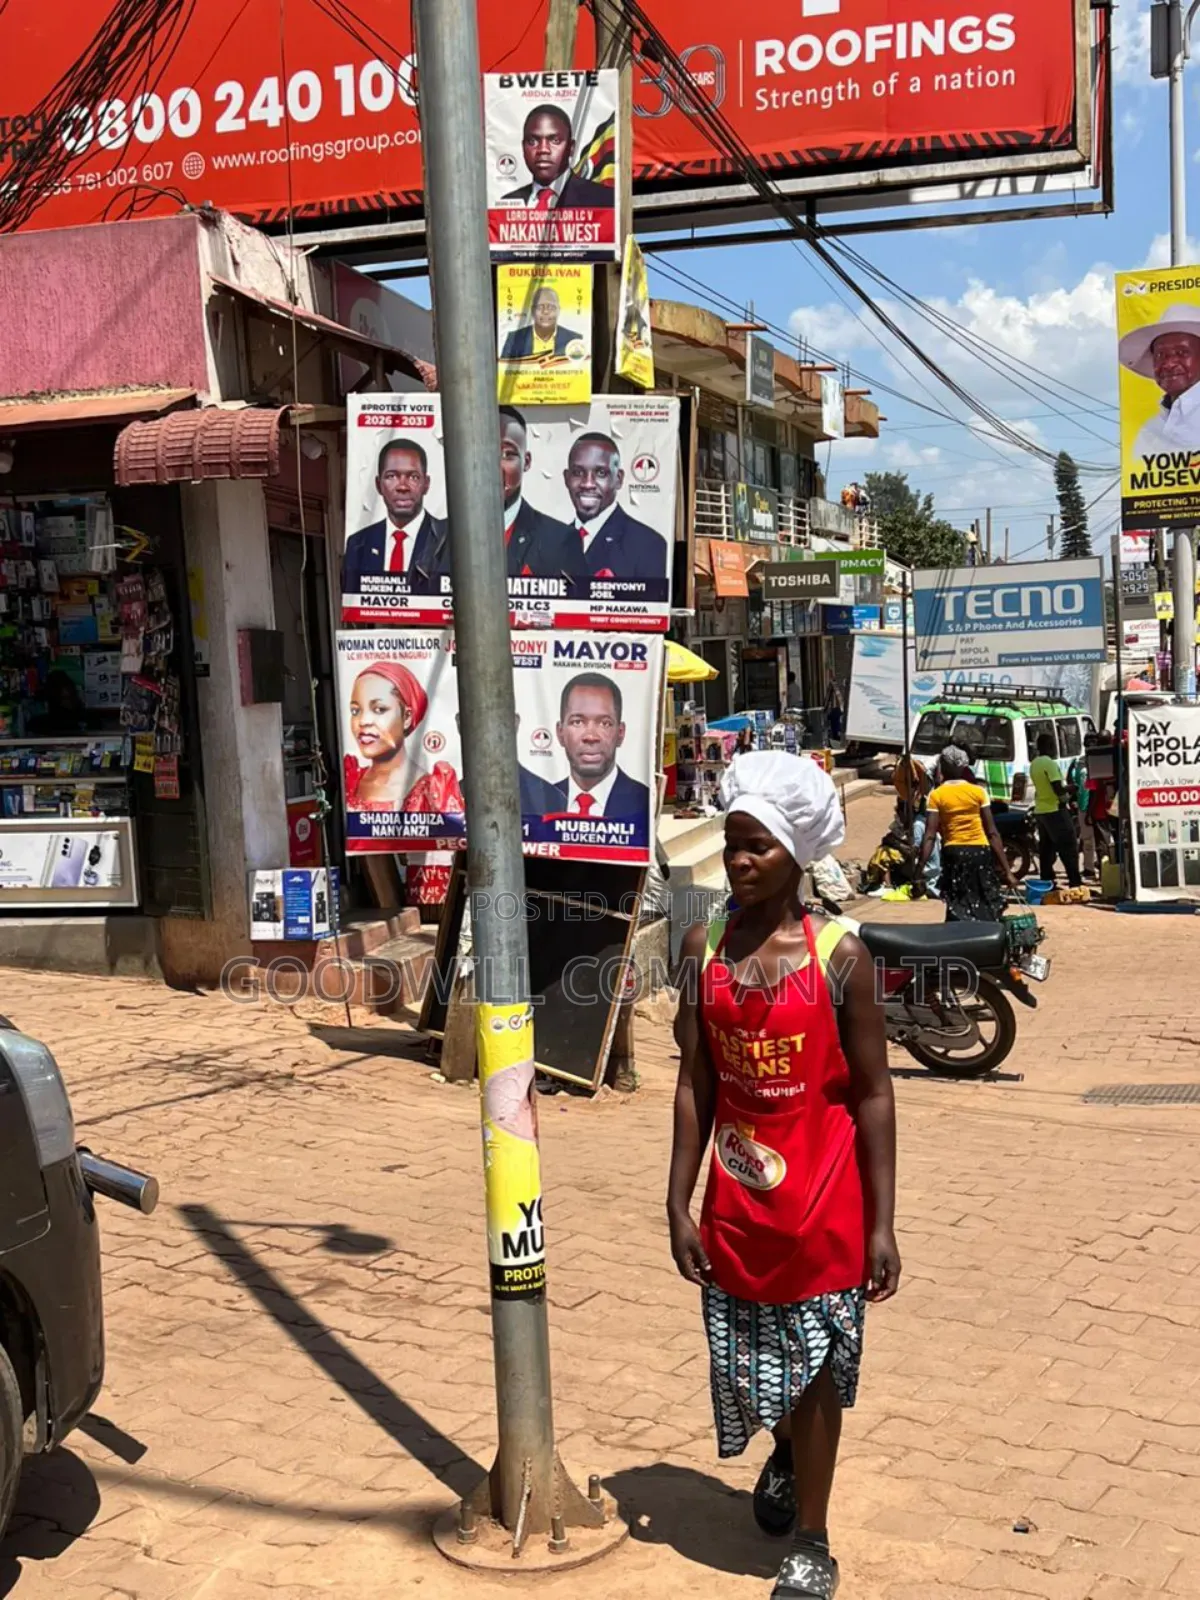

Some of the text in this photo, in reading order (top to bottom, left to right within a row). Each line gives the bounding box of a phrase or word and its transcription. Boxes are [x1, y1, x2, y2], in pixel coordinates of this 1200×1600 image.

[755, 13, 1016, 77] ROOFINGS
[499, 70, 599, 89] BWEETE
[521, 90, 552, 98] ABDUL
[755, 67, 1016, 112] Strength of a nation
[214, 69, 322, 135] 240
[211, 127, 422, 171] www.roofingsgroup.co
[142, 160, 174, 182] 607
[505, 210, 527, 221] LORD
[499, 223, 601, 242] NAKAWA WEST
[555, 268, 581, 278] IVAN
[361, 403, 434, 412] #PROTEST VOTE
[364, 415, 393, 426] 2026
[401, 415, 427, 427] 2031
[360, 575, 407, 585] NUBIANLI
[769, 573, 831, 588] TOSHIBA
[1122, 570, 1149, 581] 5050
[360, 584, 412, 593] BUKEN ALI
[590, 581, 647, 592] SSENYONYI
[590, 590, 615, 599] JOEL
[360, 595, 409, 607] MAYOR
[526, 600, 551, 611] LC3
[590, 604, 648, 613] MP NAKAWA
[972, 621, 1002, 632] Phone
[1005, 620, 1025, 630] And
[1027, 617, 1083, 628] Accessories
[338, 638, 440, 651] WOMAN COUNCILLOR
[960, 637, 975, 645] PAY
[553, 640, 648, 661] MAYOR
[960, 647, 990, 655] MPOLA
[960, 657, 990, 665] MPOLA
[1136, 721, 1172, 737] PAY
[1137, 779, 1160, 787] From
[360, 813, 445, 825] SHADIA LOUIZA
[371, 825, 430, 837] NANYANZI
[555, 820, 635, 835] NUBIANLI
[562, 832, 630, 845] BUKEN ALI
[708, 1020, 806, 1059] TASTIEST
